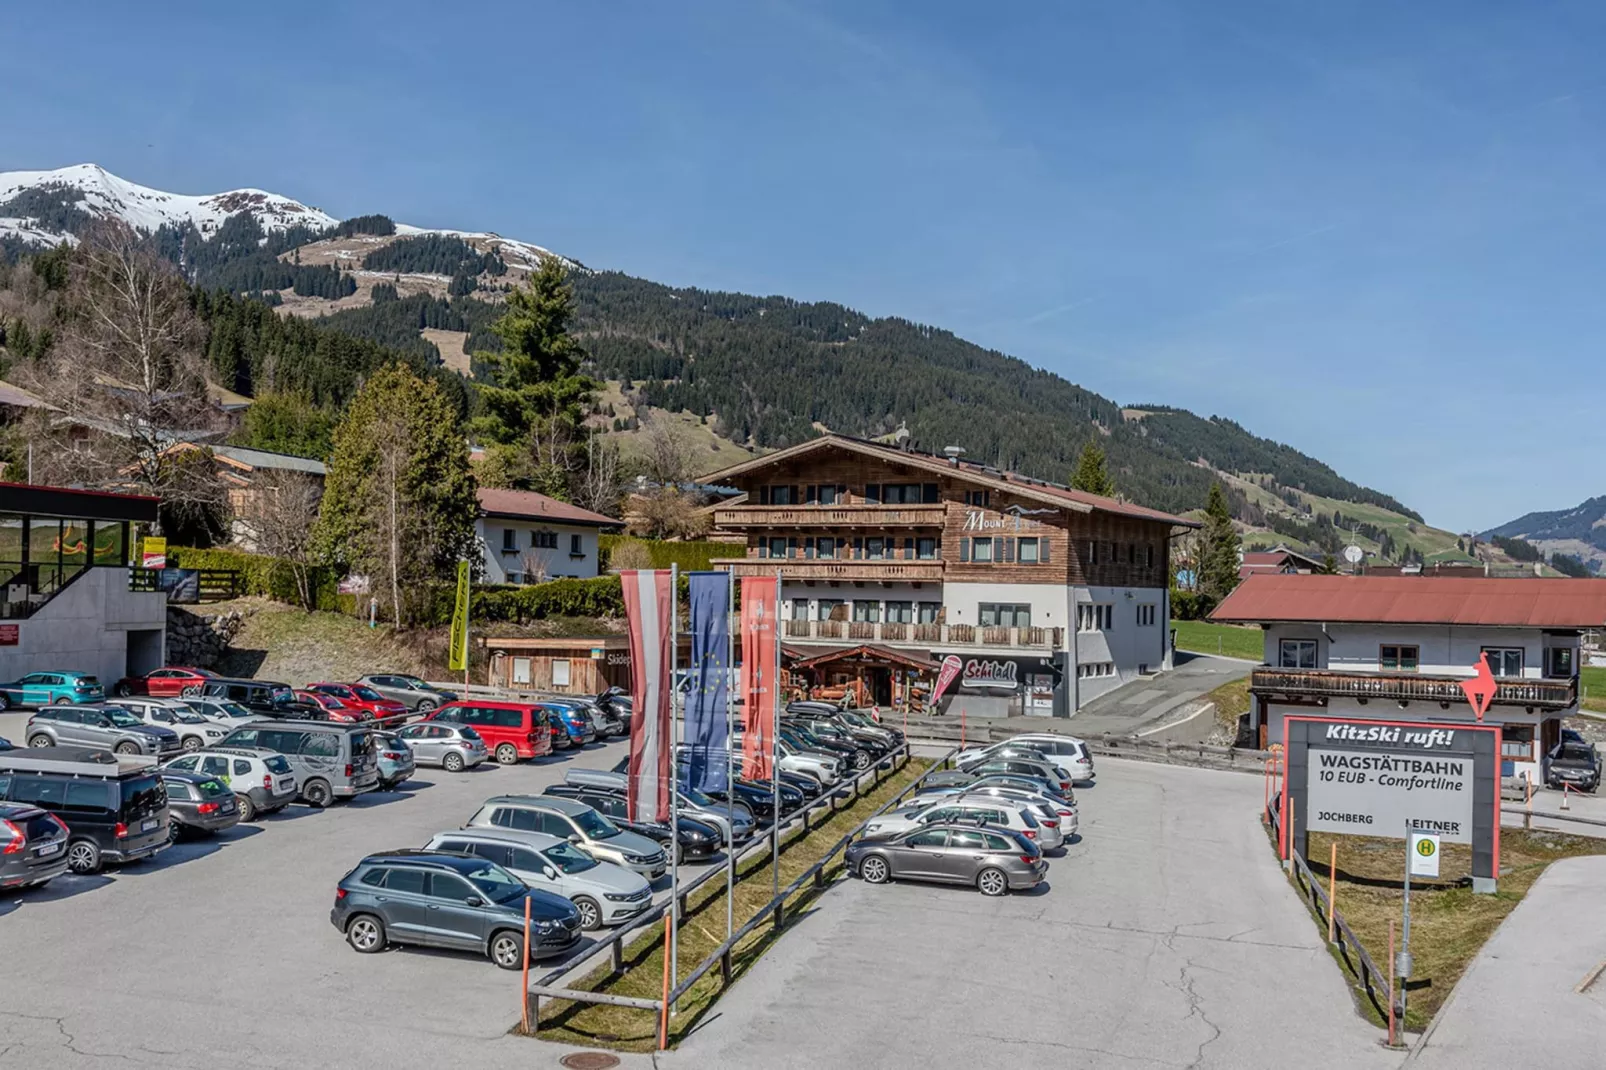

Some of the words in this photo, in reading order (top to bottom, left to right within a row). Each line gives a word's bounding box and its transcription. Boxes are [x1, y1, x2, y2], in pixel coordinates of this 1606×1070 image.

[1326, 724, 1401, 742] KitzSki
[1404, 730, 1455, 748] ruft!
[1320, 754, 1463, 776] WAGSTÄTTBAHN
[1320, 770, 1334, 782] 10
[1338, 771, 1366, 784] EUB
[1378, 774, 1463, 791] Comfortline
[1318, 811, 1373, 824] JOCHBERG
